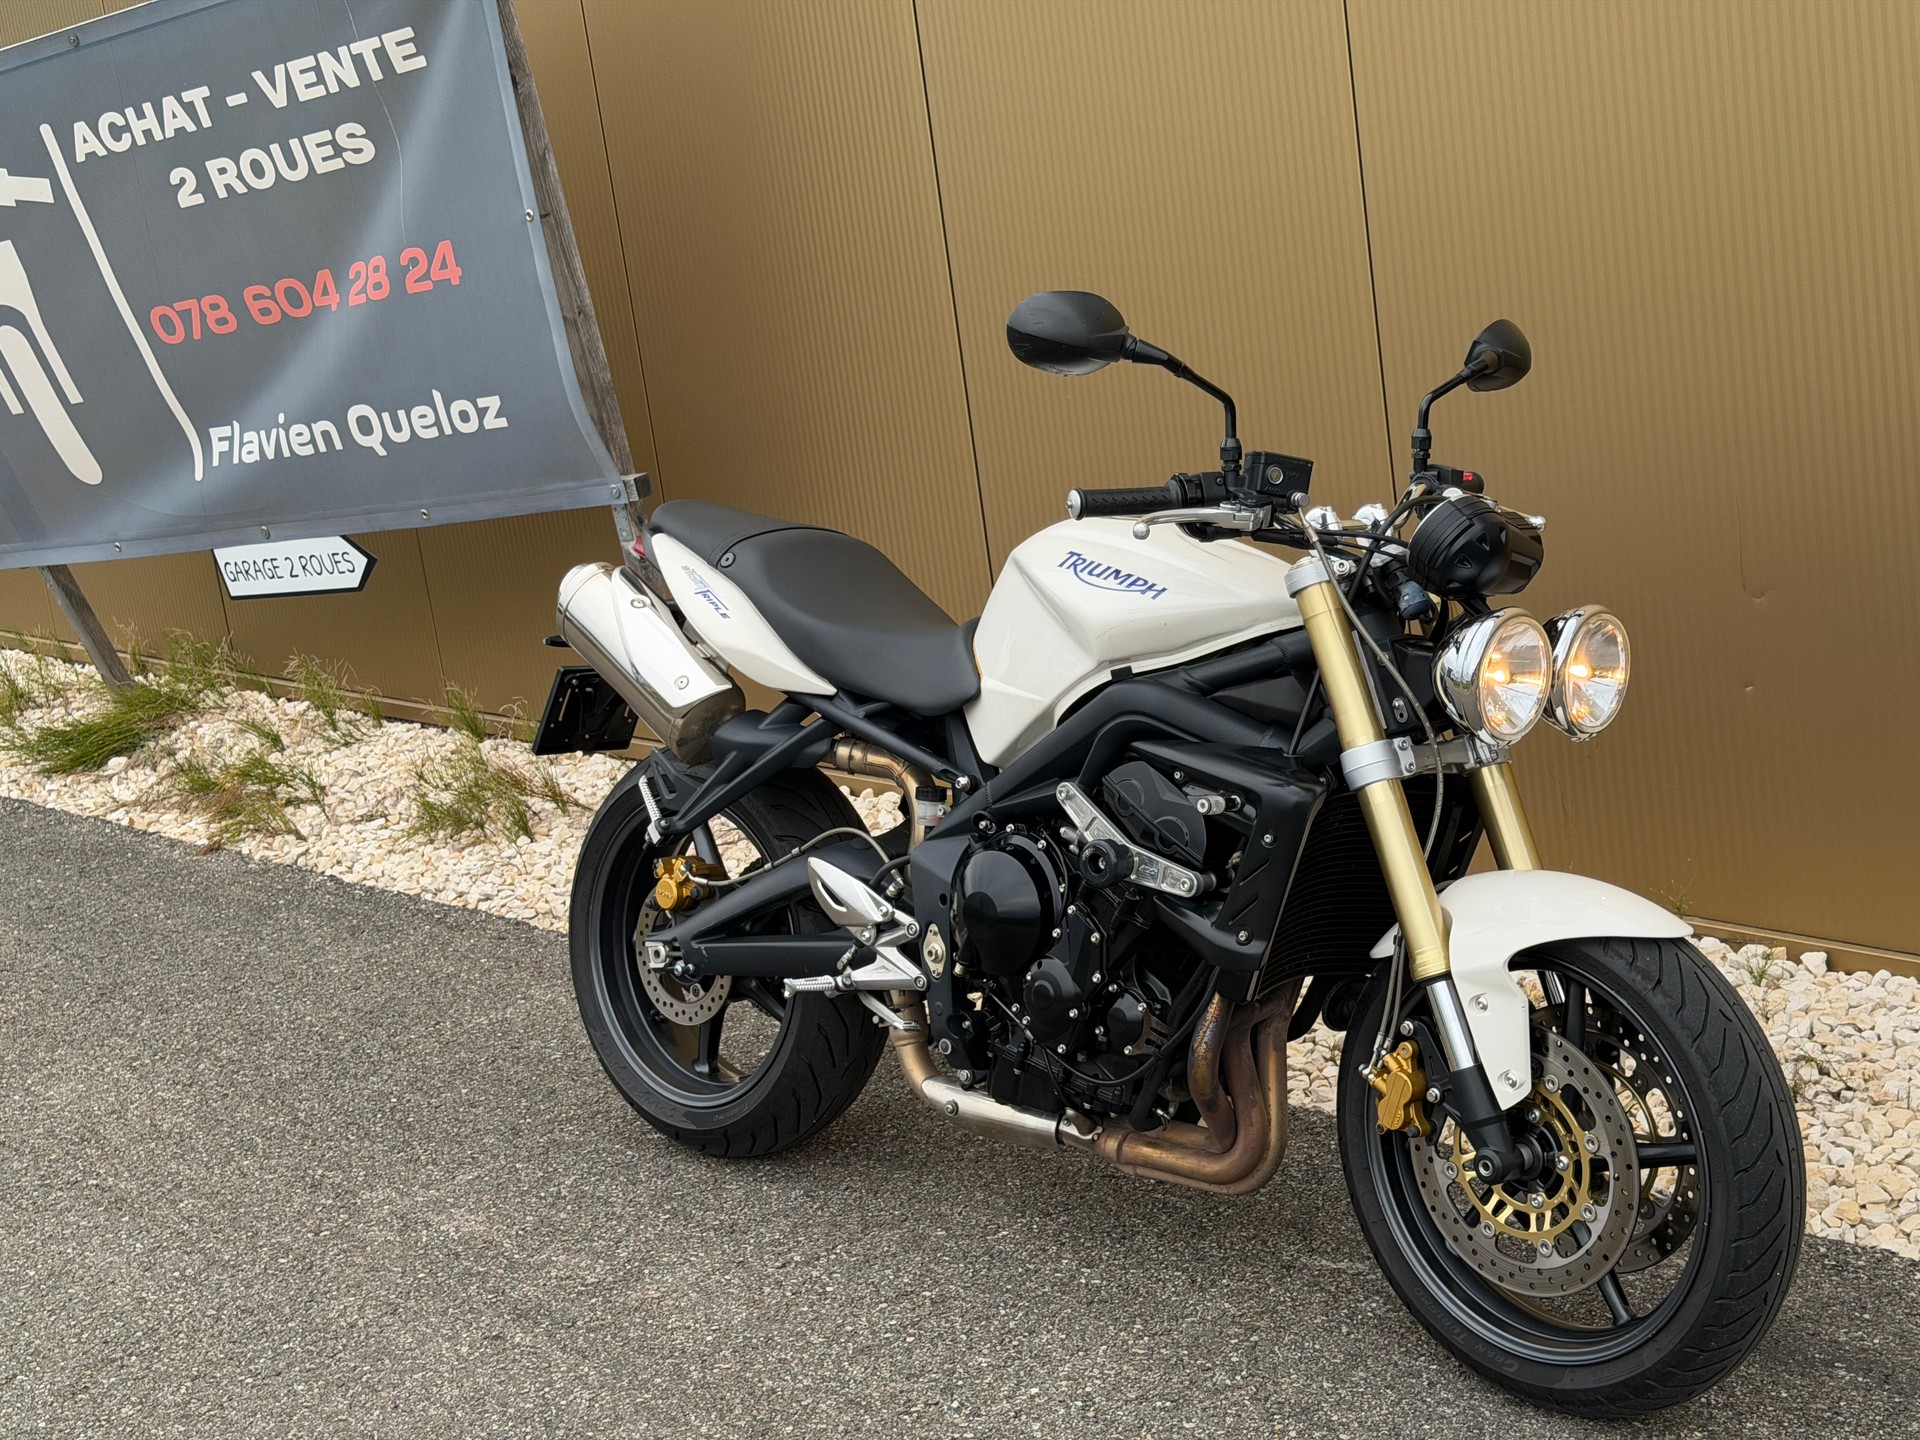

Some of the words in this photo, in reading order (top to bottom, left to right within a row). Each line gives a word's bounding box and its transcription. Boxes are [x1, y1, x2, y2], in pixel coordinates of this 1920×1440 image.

[73, 86, 213, 163] ACHAT
[225, 92, 248, 107] -
[251, 27, 428, 109] VENTE
[169, 167, 205, 208] 2
[204, 122, 376, 199] ROUES
[150, 295, 238, 344] 078
[244, 269, 340, 325] 604
[348, 256, 390, 306] 28
[400, 240, 462, 294] 24
[208, 413, 344, 467] Flavien
[347, 389, 509, 456] Queloz
[223, 557, 285, 583] GARAGE
[284, 556, 300, 578] 2
[298, 551, 356, 578] ROUES
[1057, 551, 1168, 600] TRIUMPH
